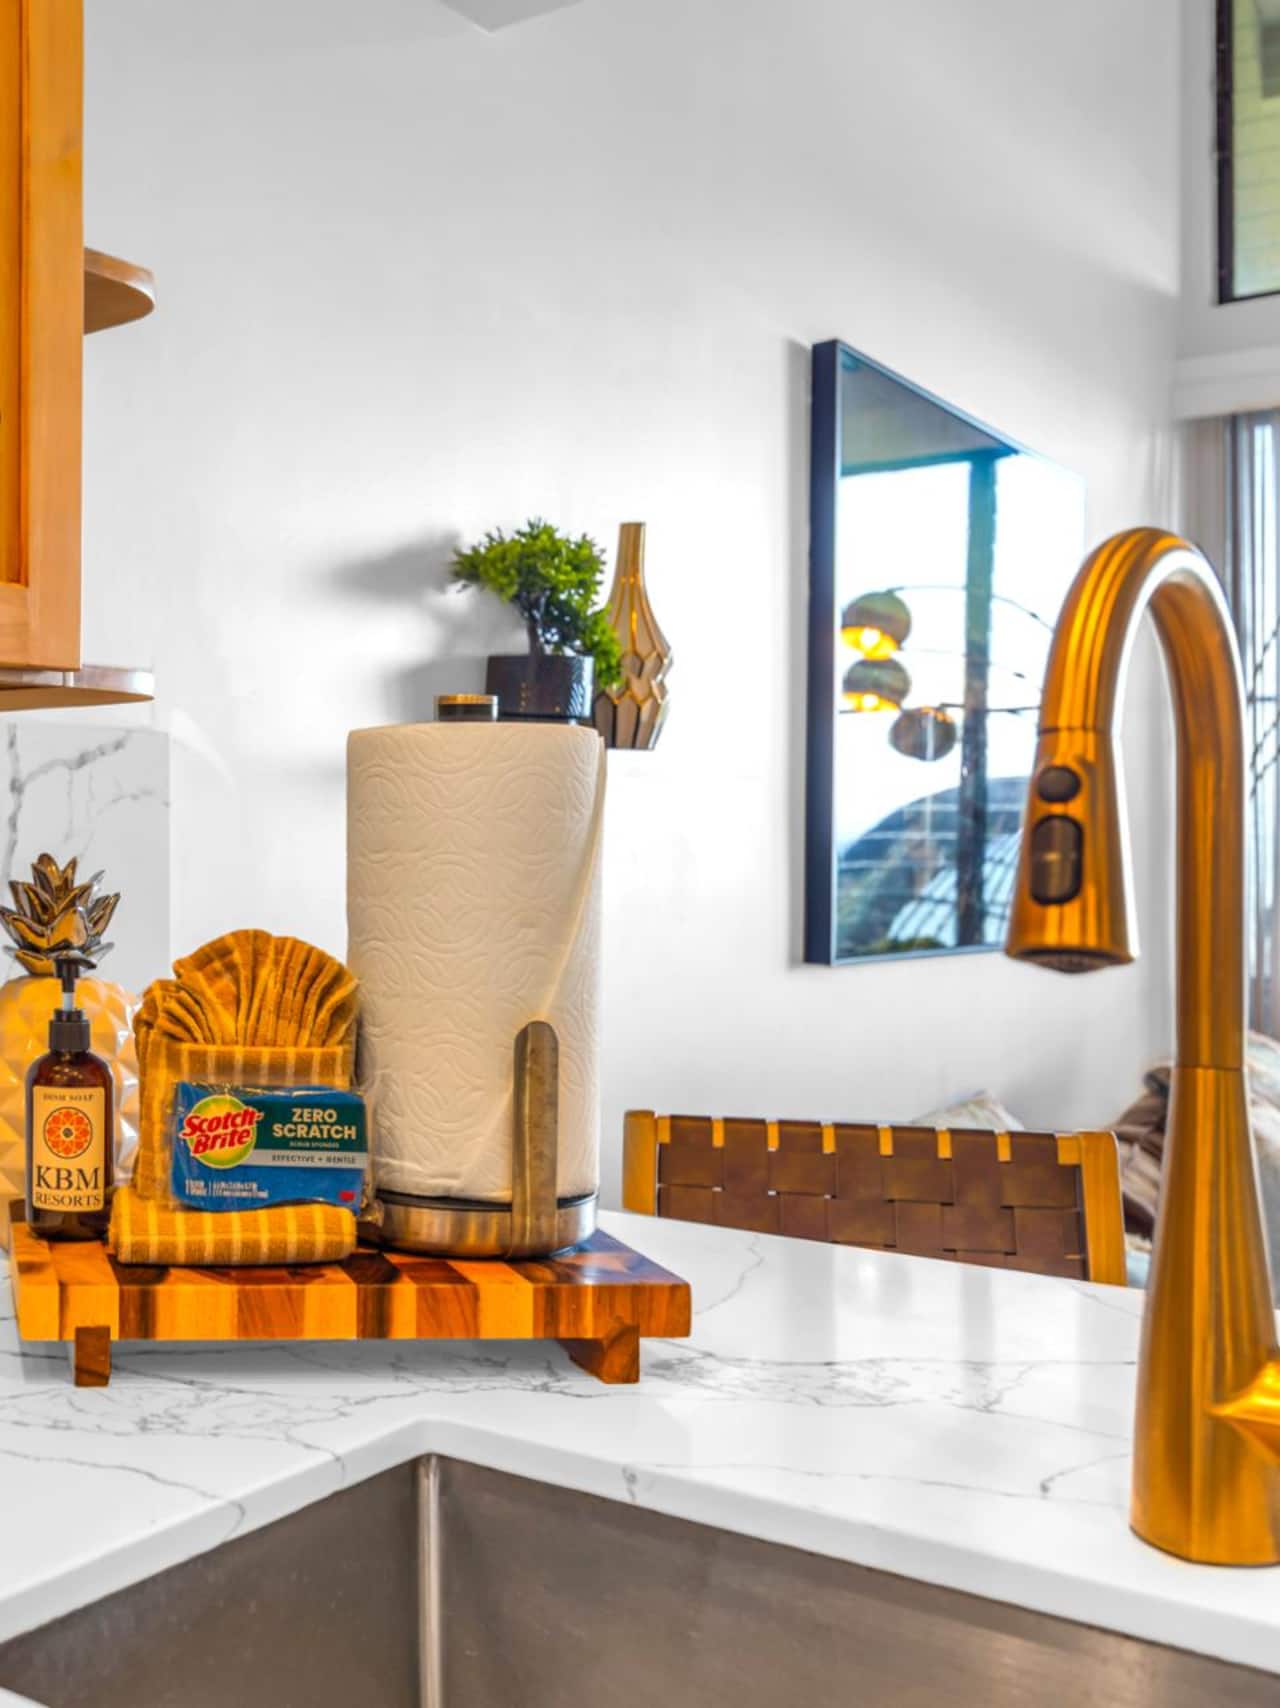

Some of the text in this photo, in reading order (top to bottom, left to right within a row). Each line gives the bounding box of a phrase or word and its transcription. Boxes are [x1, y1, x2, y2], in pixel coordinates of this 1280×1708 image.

[291, 1107, 338, 1124] ZERO
[272, 1122, 357, 1140] SCRATCH
[192, 1128, 252, 1155] Brite
[35, 1165, 101, 1191] KBM
[35, 1191, 101, 1207] RESORTS
